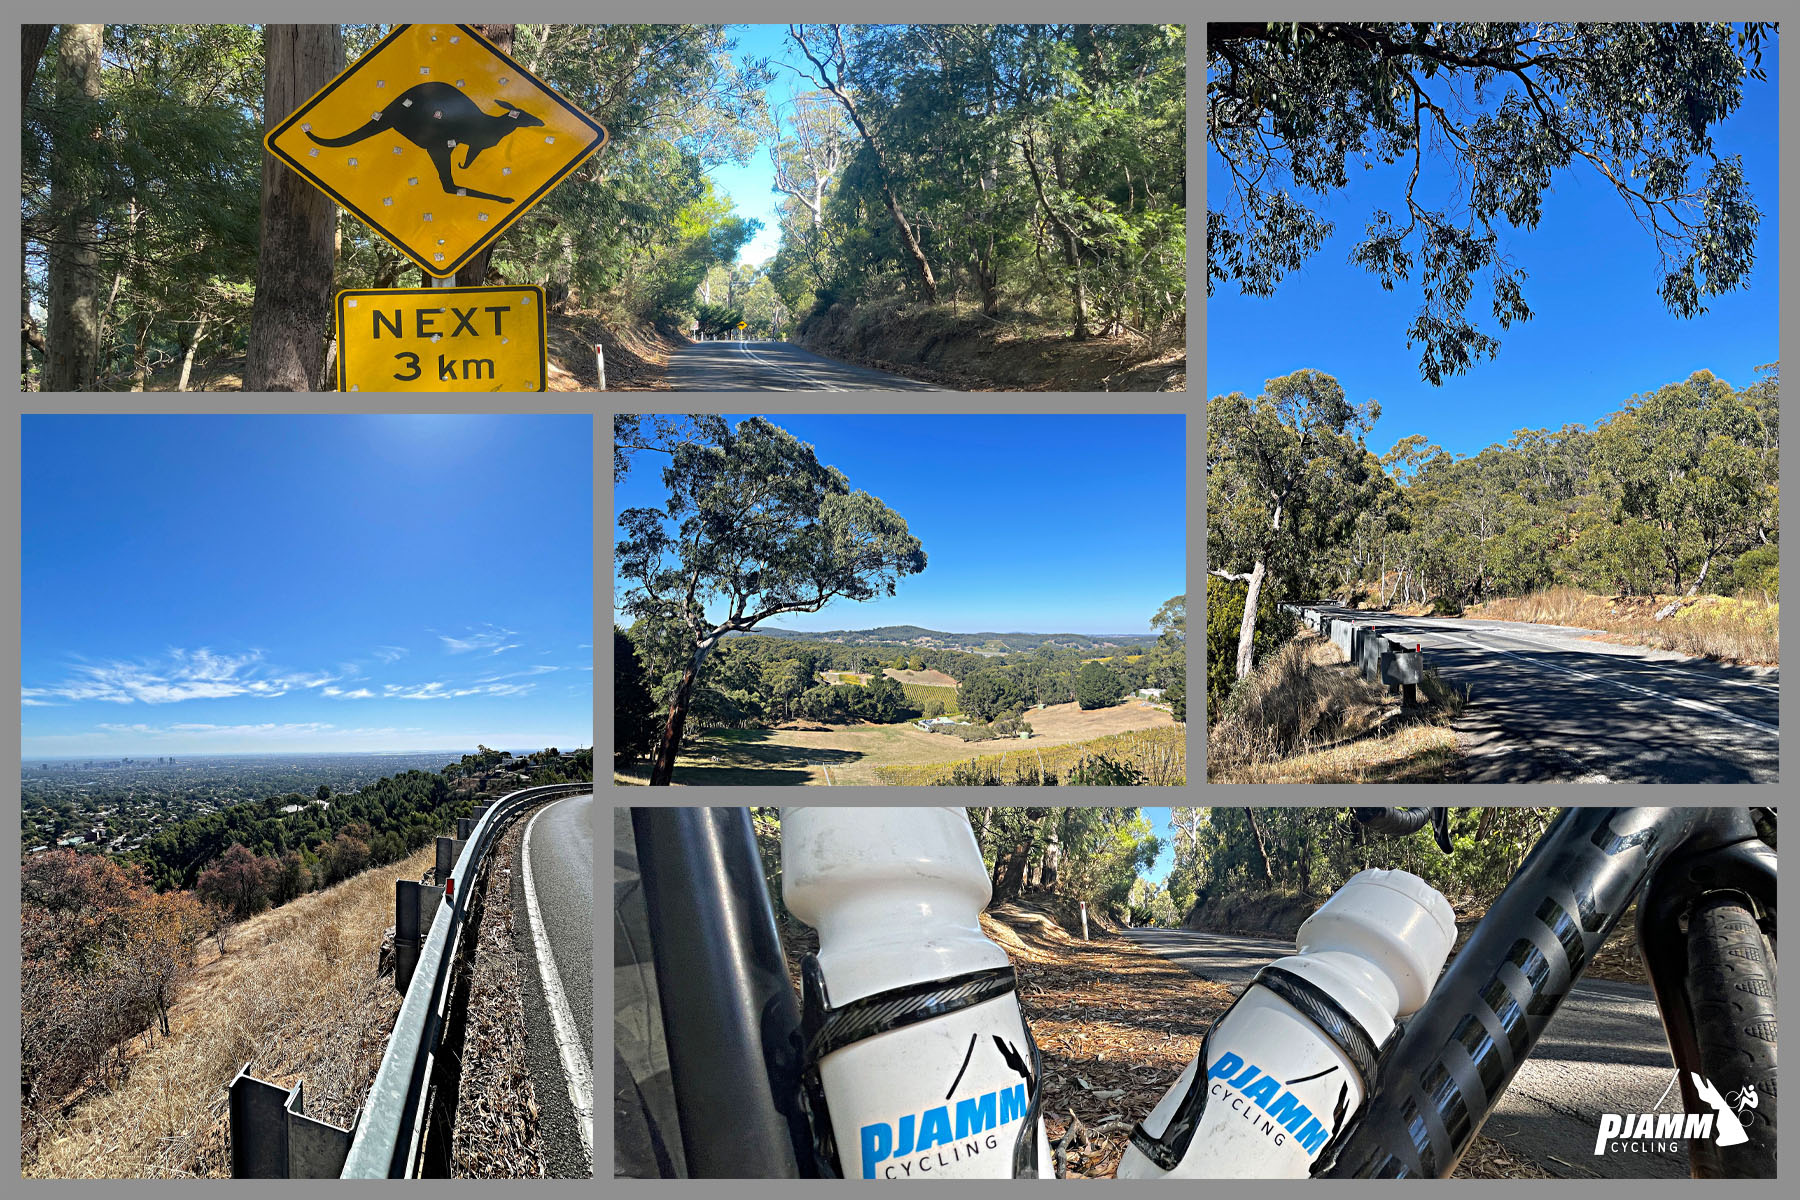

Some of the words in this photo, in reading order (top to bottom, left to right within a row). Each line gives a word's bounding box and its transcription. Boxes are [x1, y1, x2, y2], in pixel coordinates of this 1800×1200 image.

[372, 306, 511, 339] NEXT
[393, 351, 422, 382] 3
[438, 353, 495, 382] km
[860, 1083, 1028, 1179] PJAMM
[1208, 1051, 1329, 1157] PJAMM
[1211, 1083, 1287, 1148] CYCLING
[885, 1134, 998, 1179] CYCLING
